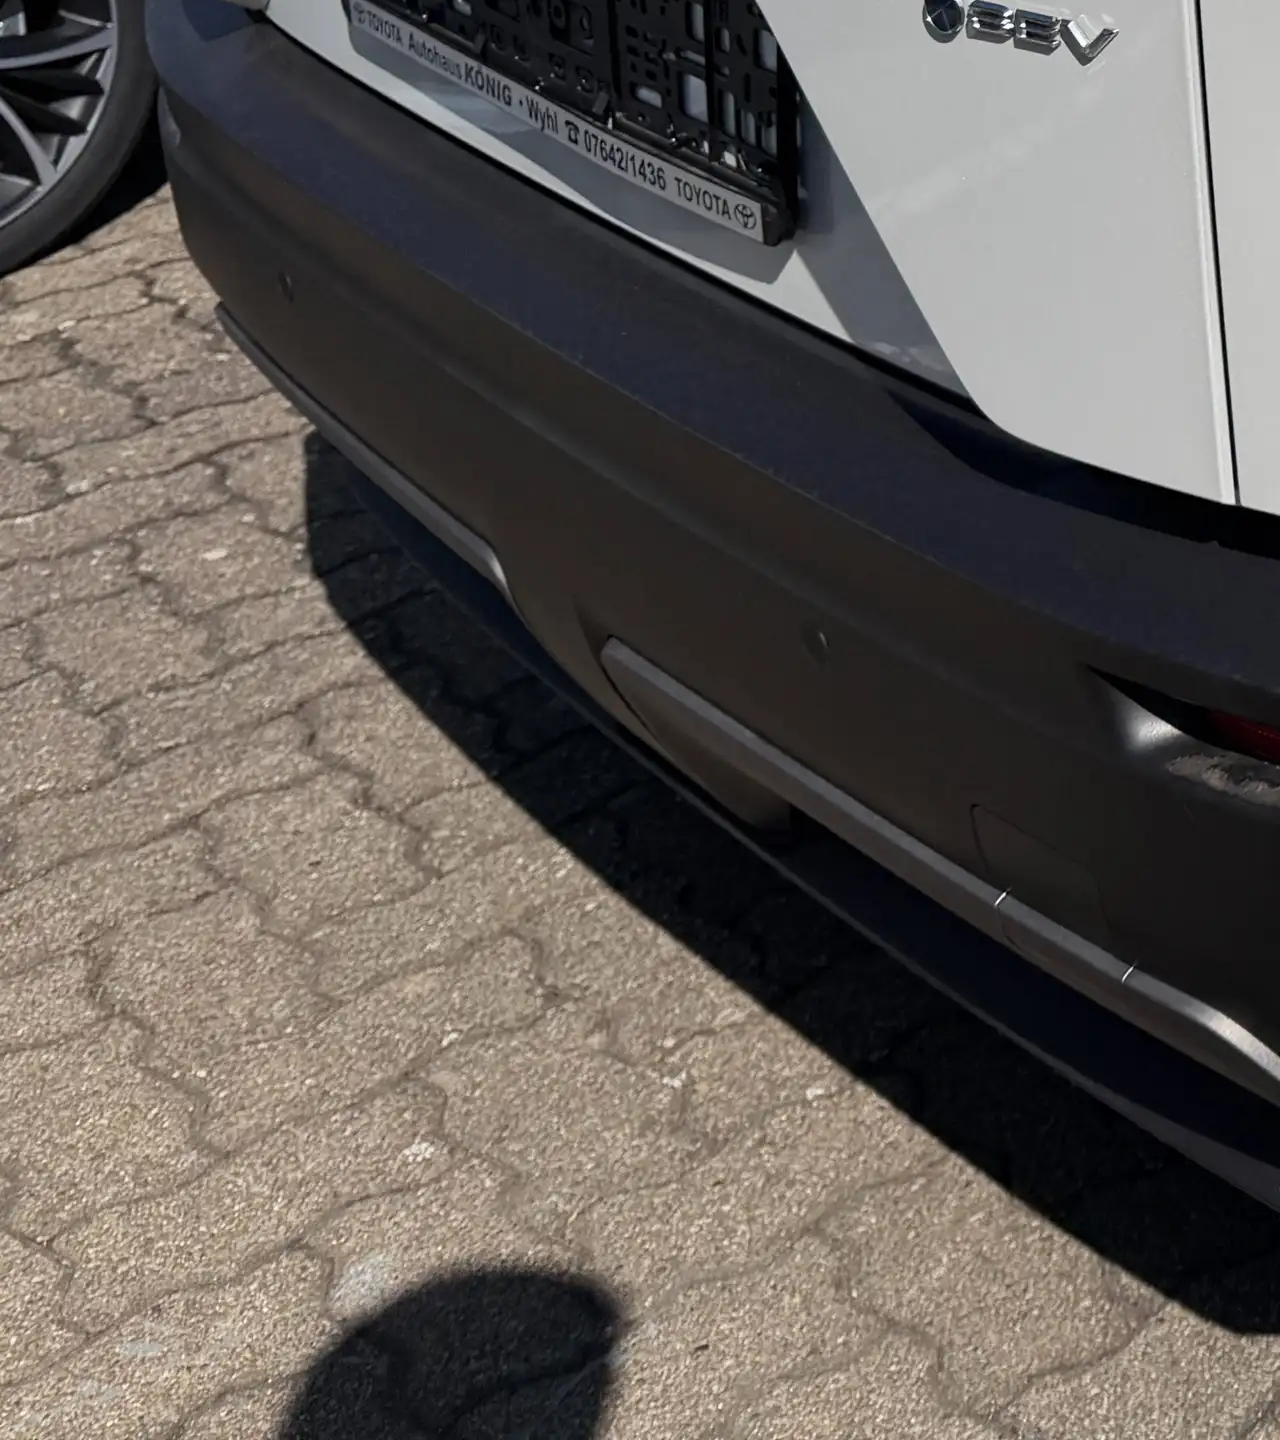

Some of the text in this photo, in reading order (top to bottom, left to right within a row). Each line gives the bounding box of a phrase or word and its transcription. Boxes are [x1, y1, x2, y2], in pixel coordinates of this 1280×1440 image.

[366, 10, 732, 220] TOYOTA Autohaus KÖNIG Wyhl 07642/1436 TOYOTA
